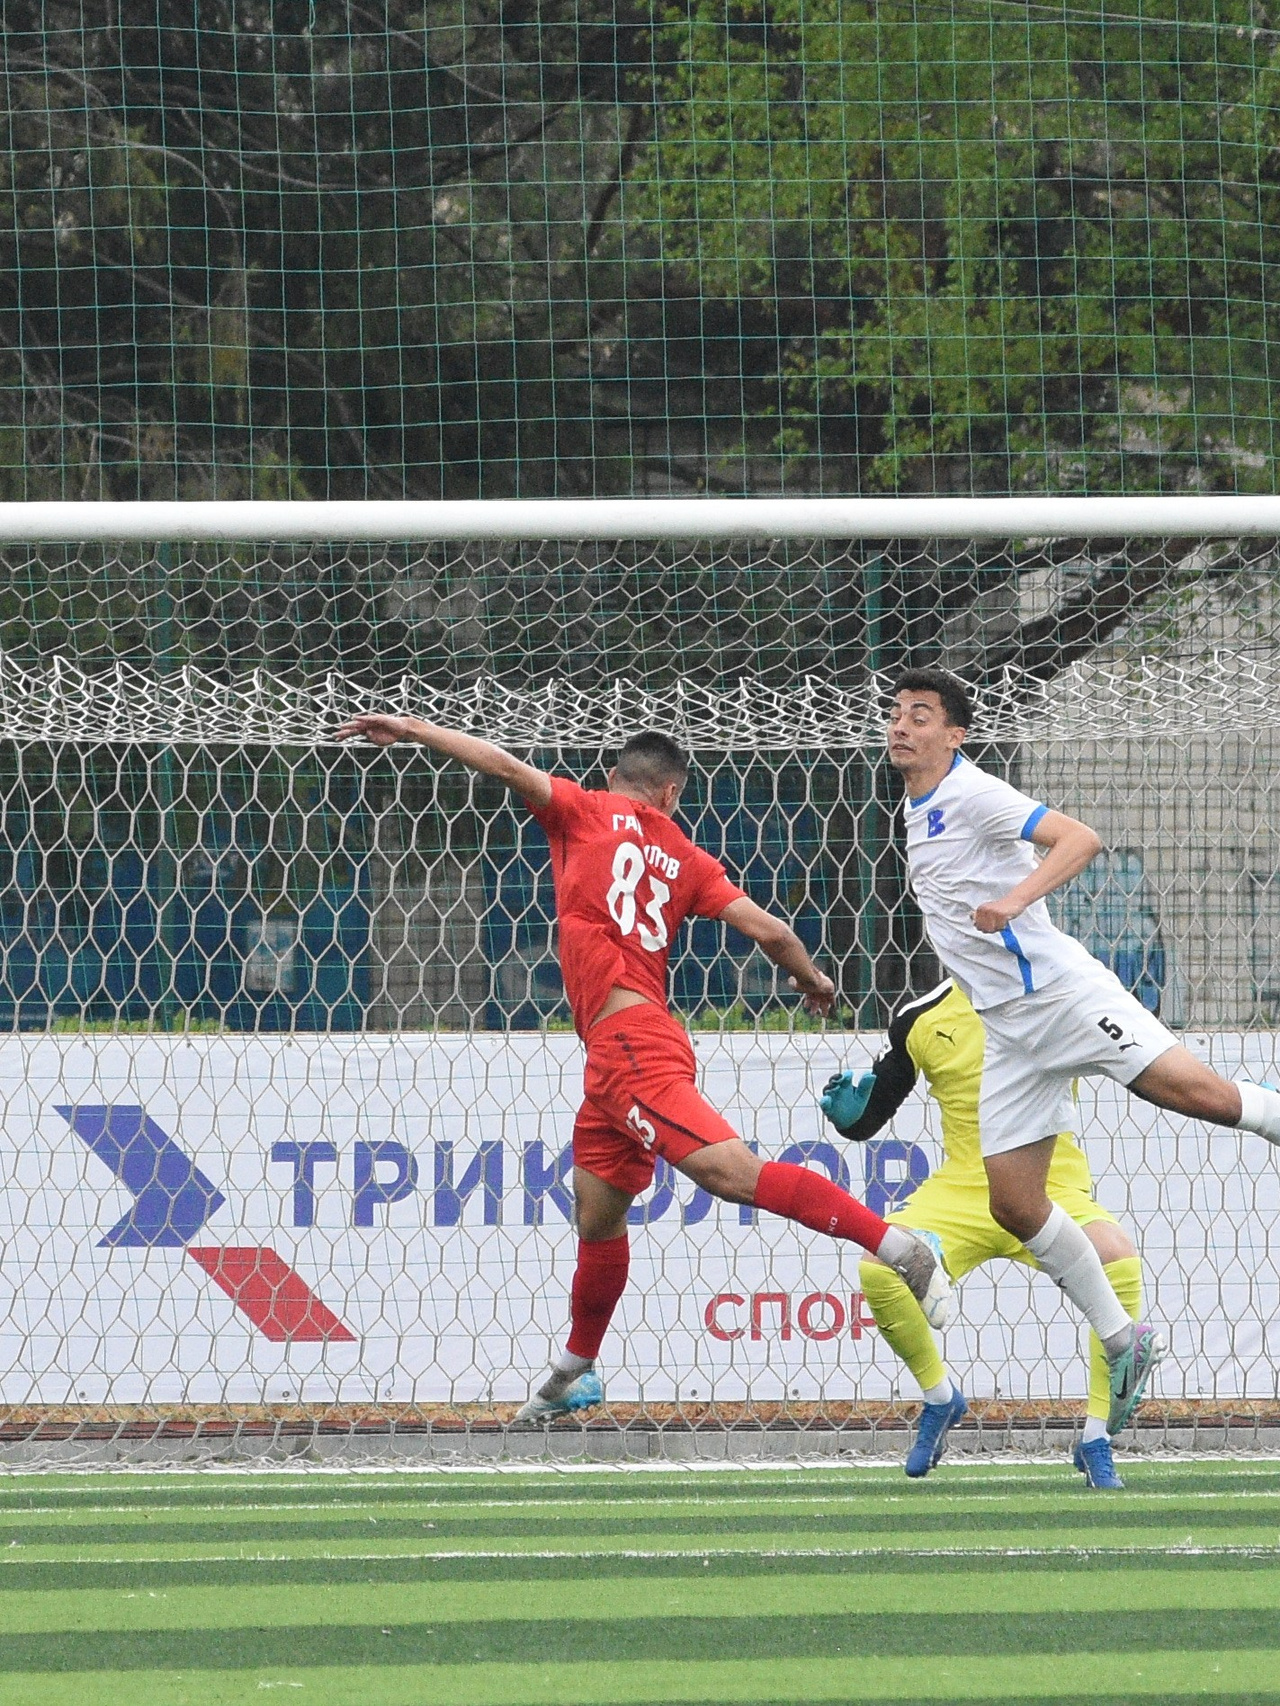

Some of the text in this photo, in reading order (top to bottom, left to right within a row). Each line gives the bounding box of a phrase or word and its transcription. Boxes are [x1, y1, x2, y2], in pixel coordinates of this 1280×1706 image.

[605, 841, 671, 952] 83
[1098, 1016, 1124, 1041] 5
[626, 1104, 656, 1151] 3
[704, 1292, 877, 1341] СПОР
